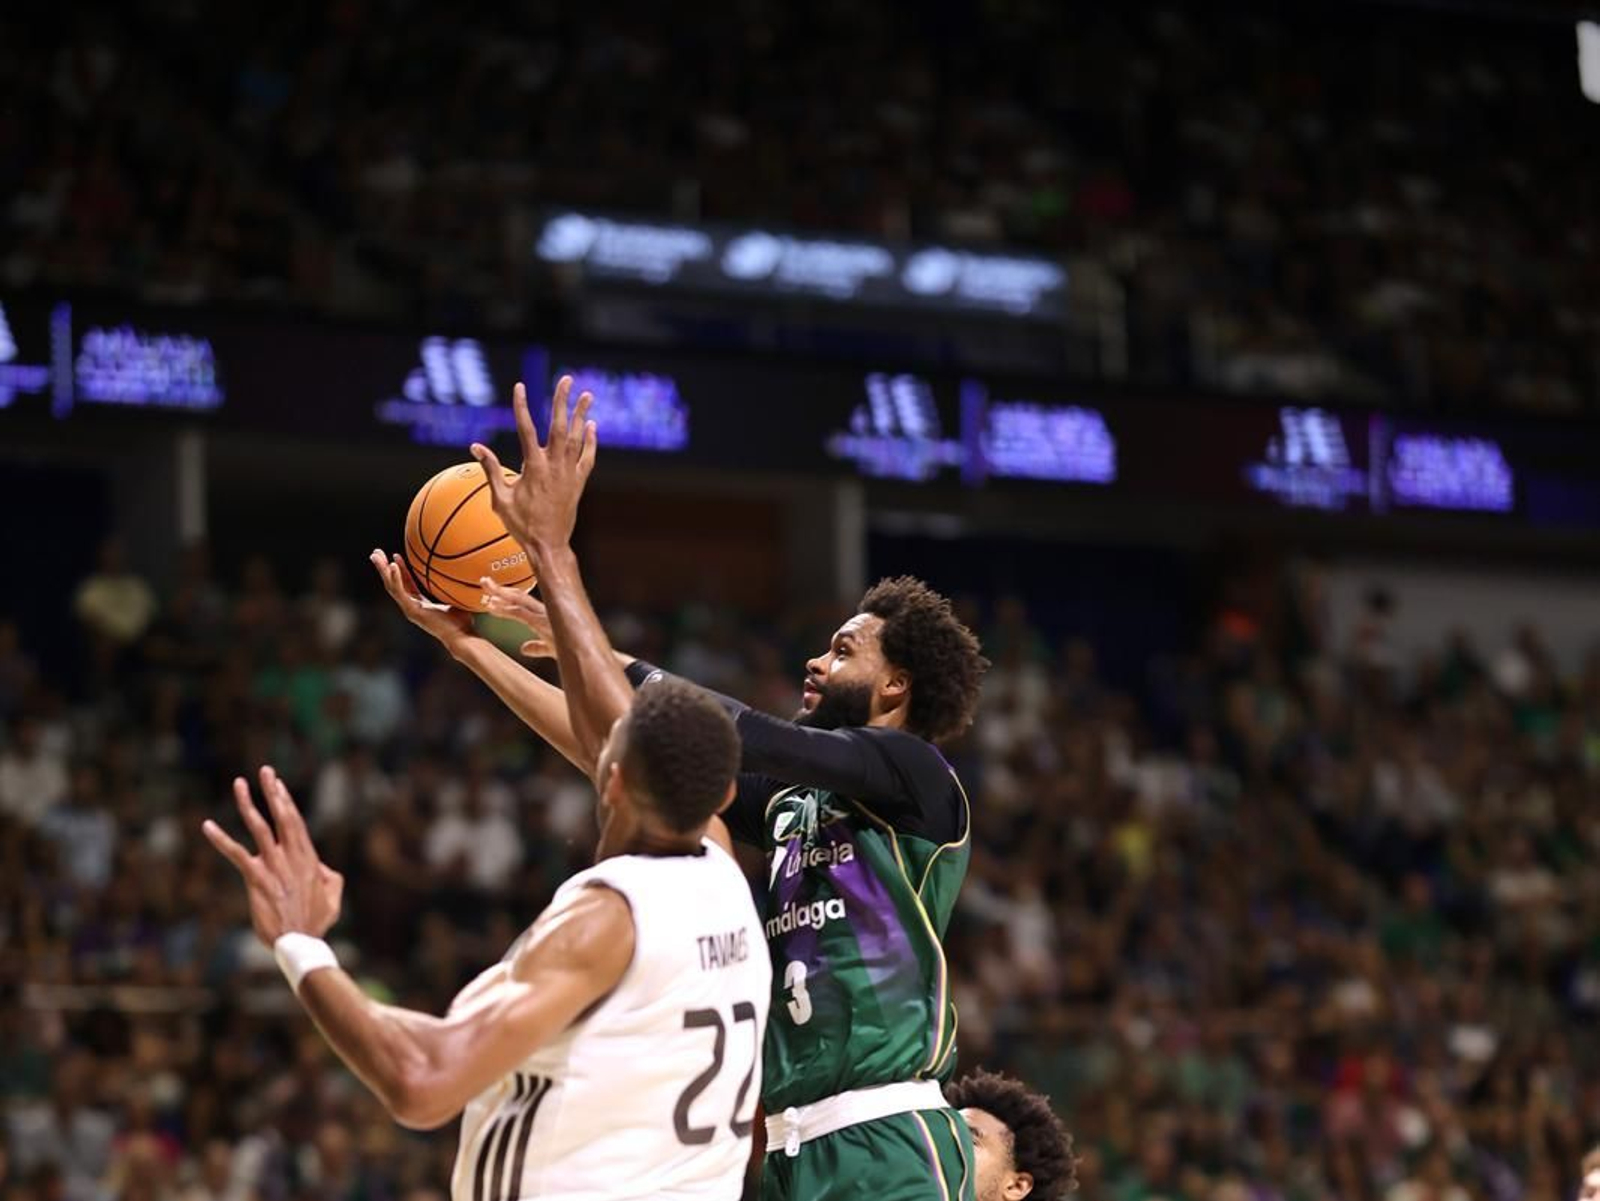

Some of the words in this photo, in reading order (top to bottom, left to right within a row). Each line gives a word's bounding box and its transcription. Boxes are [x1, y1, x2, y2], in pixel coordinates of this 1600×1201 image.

[766, 898, 845, 940] málaga
[783, 960, 812, 1026] 3
[674, 1001, 757, 1146] 22
